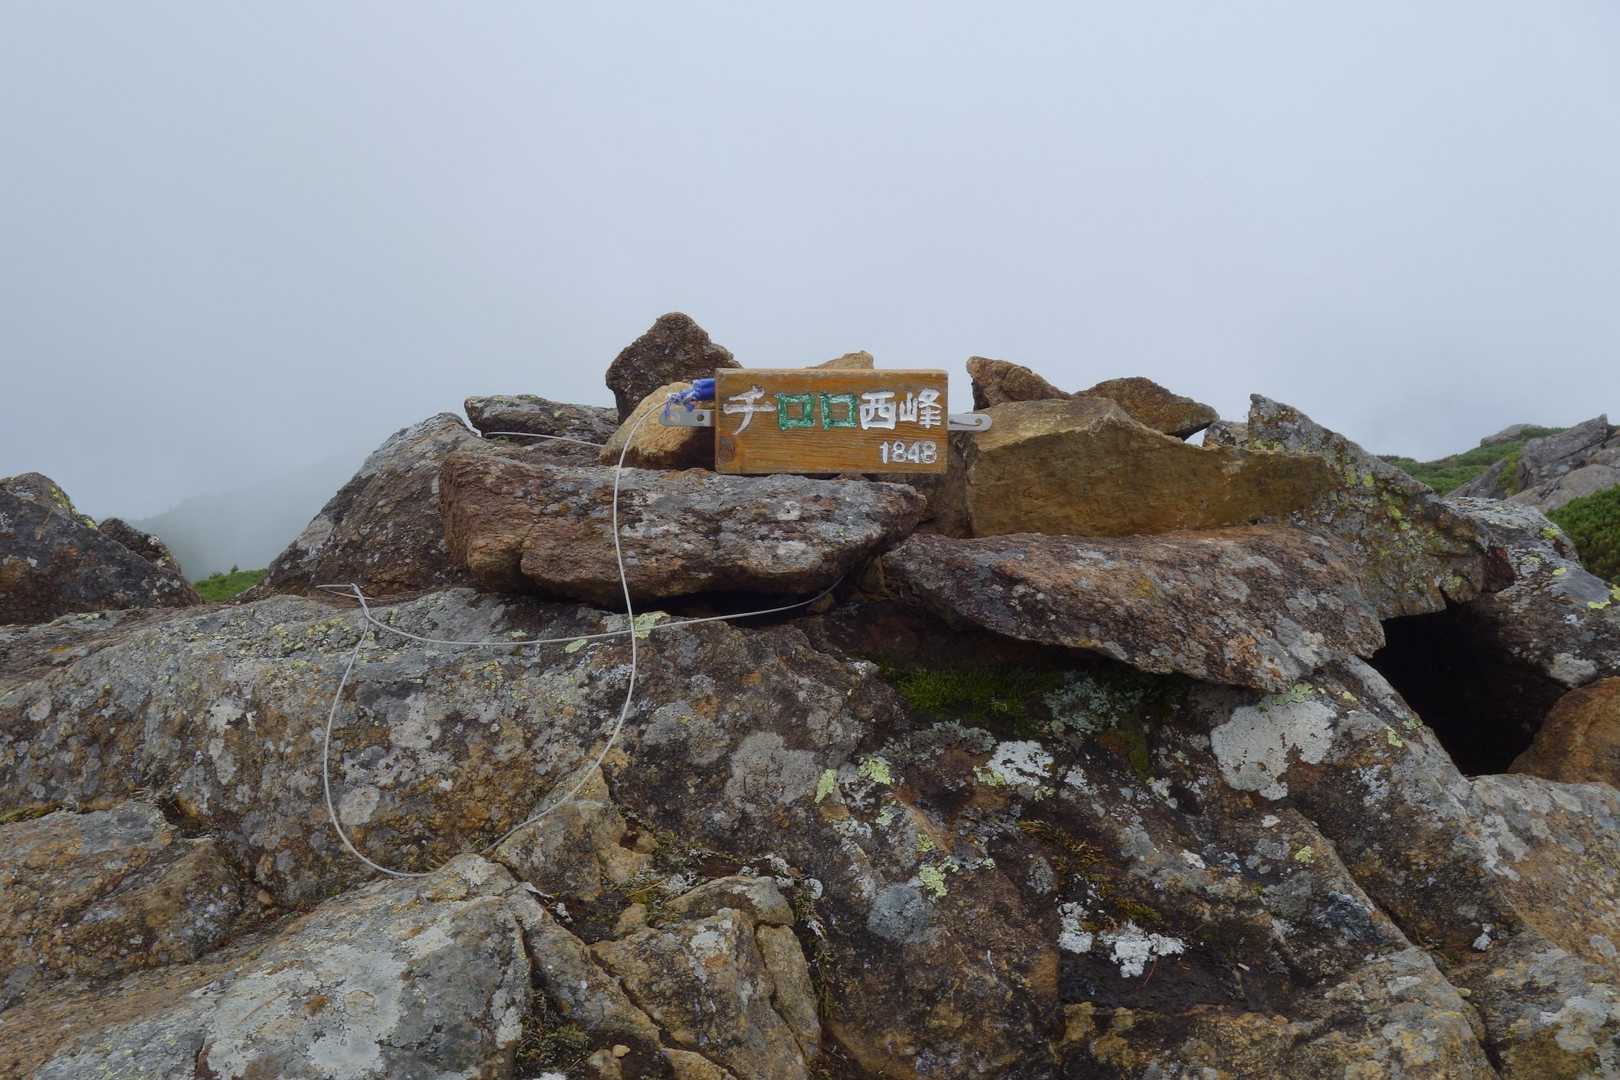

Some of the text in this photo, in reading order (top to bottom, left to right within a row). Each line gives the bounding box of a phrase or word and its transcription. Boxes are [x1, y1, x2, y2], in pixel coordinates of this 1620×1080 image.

[723, 385, 942, 435] チロロ西峰
[880, 440, 937, 464] 1848
